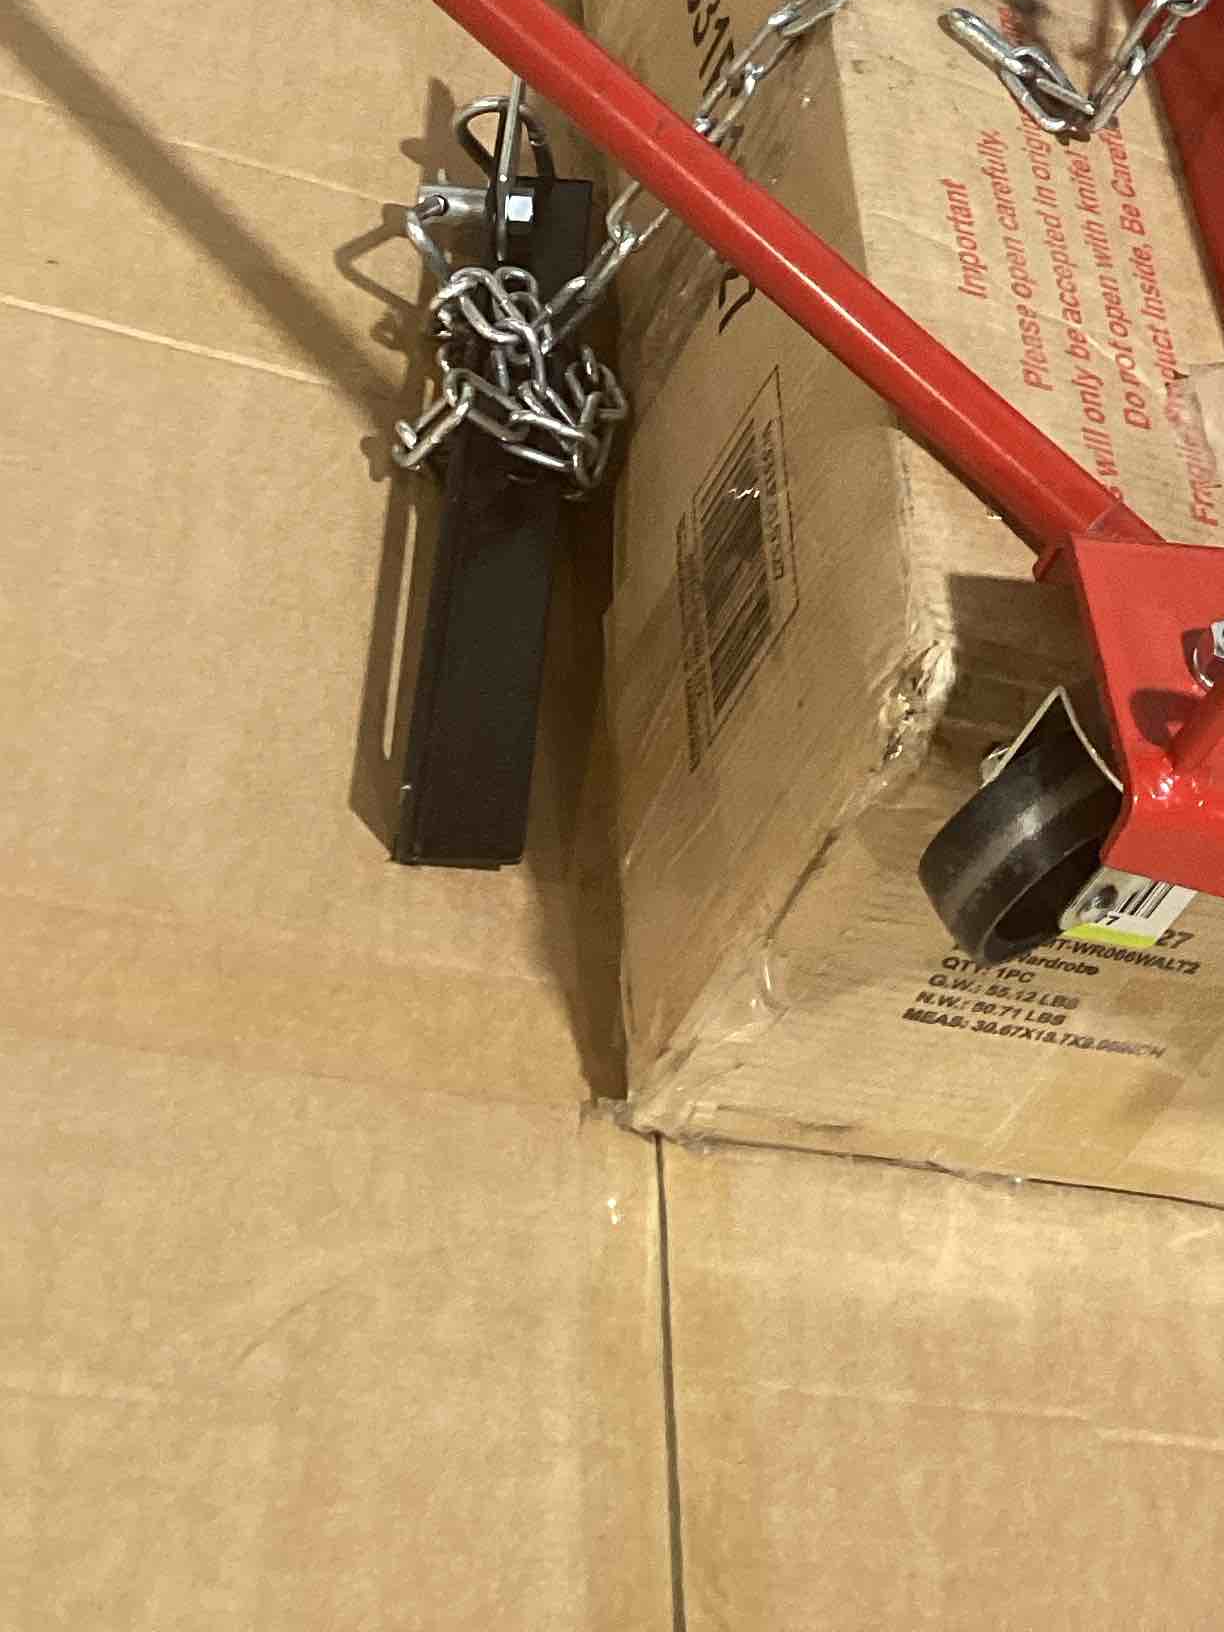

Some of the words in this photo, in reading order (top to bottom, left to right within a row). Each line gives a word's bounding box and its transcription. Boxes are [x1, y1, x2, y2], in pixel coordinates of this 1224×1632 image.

[1019, 112, 1055, 181] origin
[977, 129, 1019, 231] carefully.
[1033, 187, 1056, 208] in
[1063, 148, 1103, 216] knife!
[940, 177, 991, 300] Important
[1116, 202, 1144, 235] Be
[1002, 236, 1034, 299] open
[1038, 213, 1085, 325] accepted
[1081, 222, 1112, 269] with
[1132, 241, 1166, 320] Inside,
[1099, 274, 1134, 338] open
[1014, 308, 1054, 392] Please
[1067, 328, 1093, 359] be
[1106, 342, 1142, 387] not
[1071, 368, 1107, 424] only
[1122, 392, 1153, 430] Do
[1081, 427, 1120, 477] will
[985, 983, 1037, 1004] 55.12
[1039, 992, 1081, 1010] LBS
[995, 966, 1036, 984] 1PC
[902, 1007, 968, 1029] MEAS:
[971, 999, 1023, 1021] 50.71
[1024, 1010, 1067, 1026] LBS
